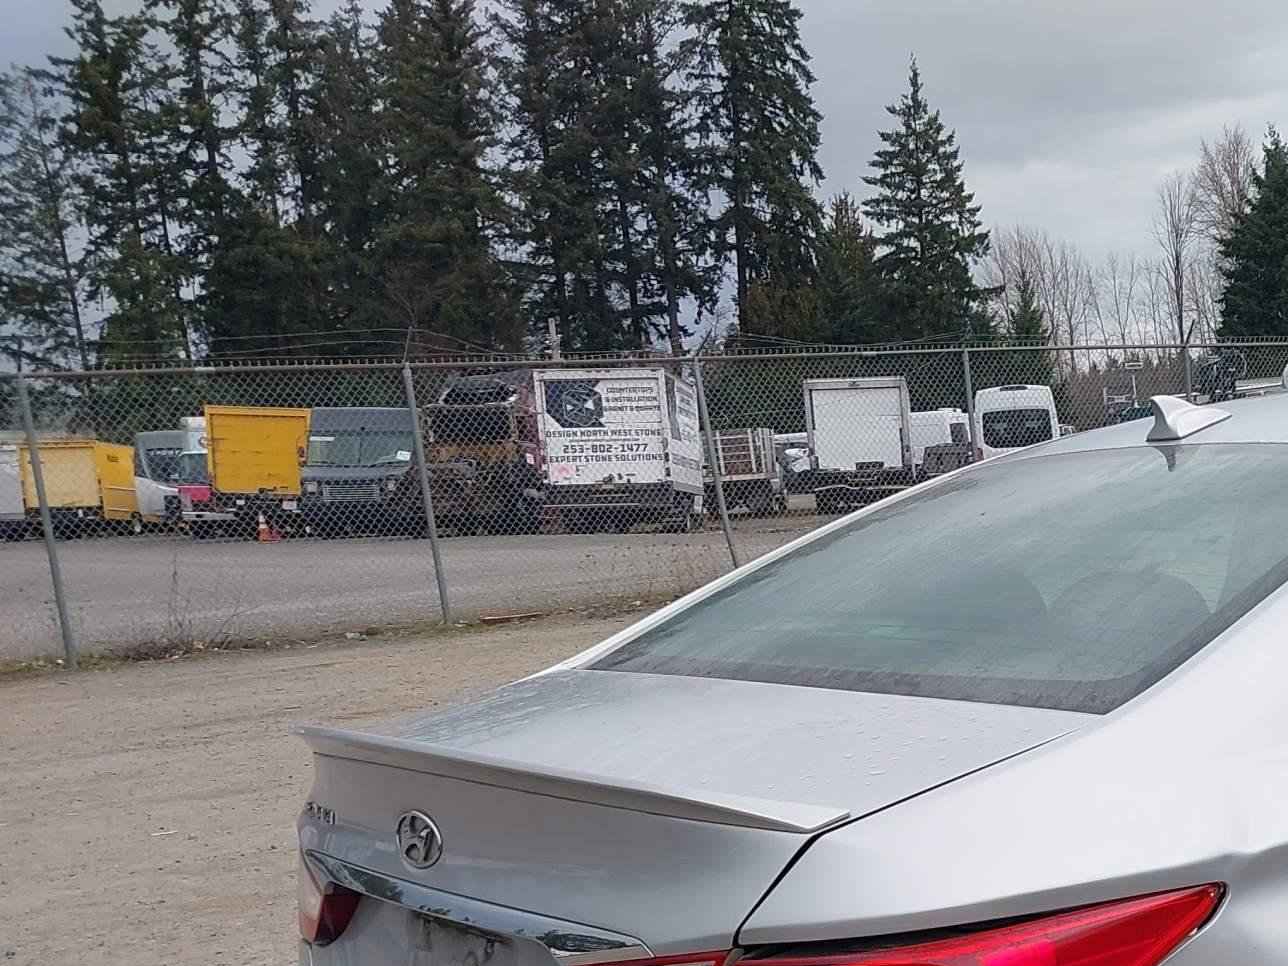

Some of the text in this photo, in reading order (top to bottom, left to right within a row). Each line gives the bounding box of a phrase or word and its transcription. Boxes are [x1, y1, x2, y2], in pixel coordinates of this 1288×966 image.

[546, 428, 662, 438] DESIGN NORTH WEST STONE
[563, 443, 648, 454] 253-802-1477
[549, 453, 664, 463] EXPERT STONE SOLUTIONS
